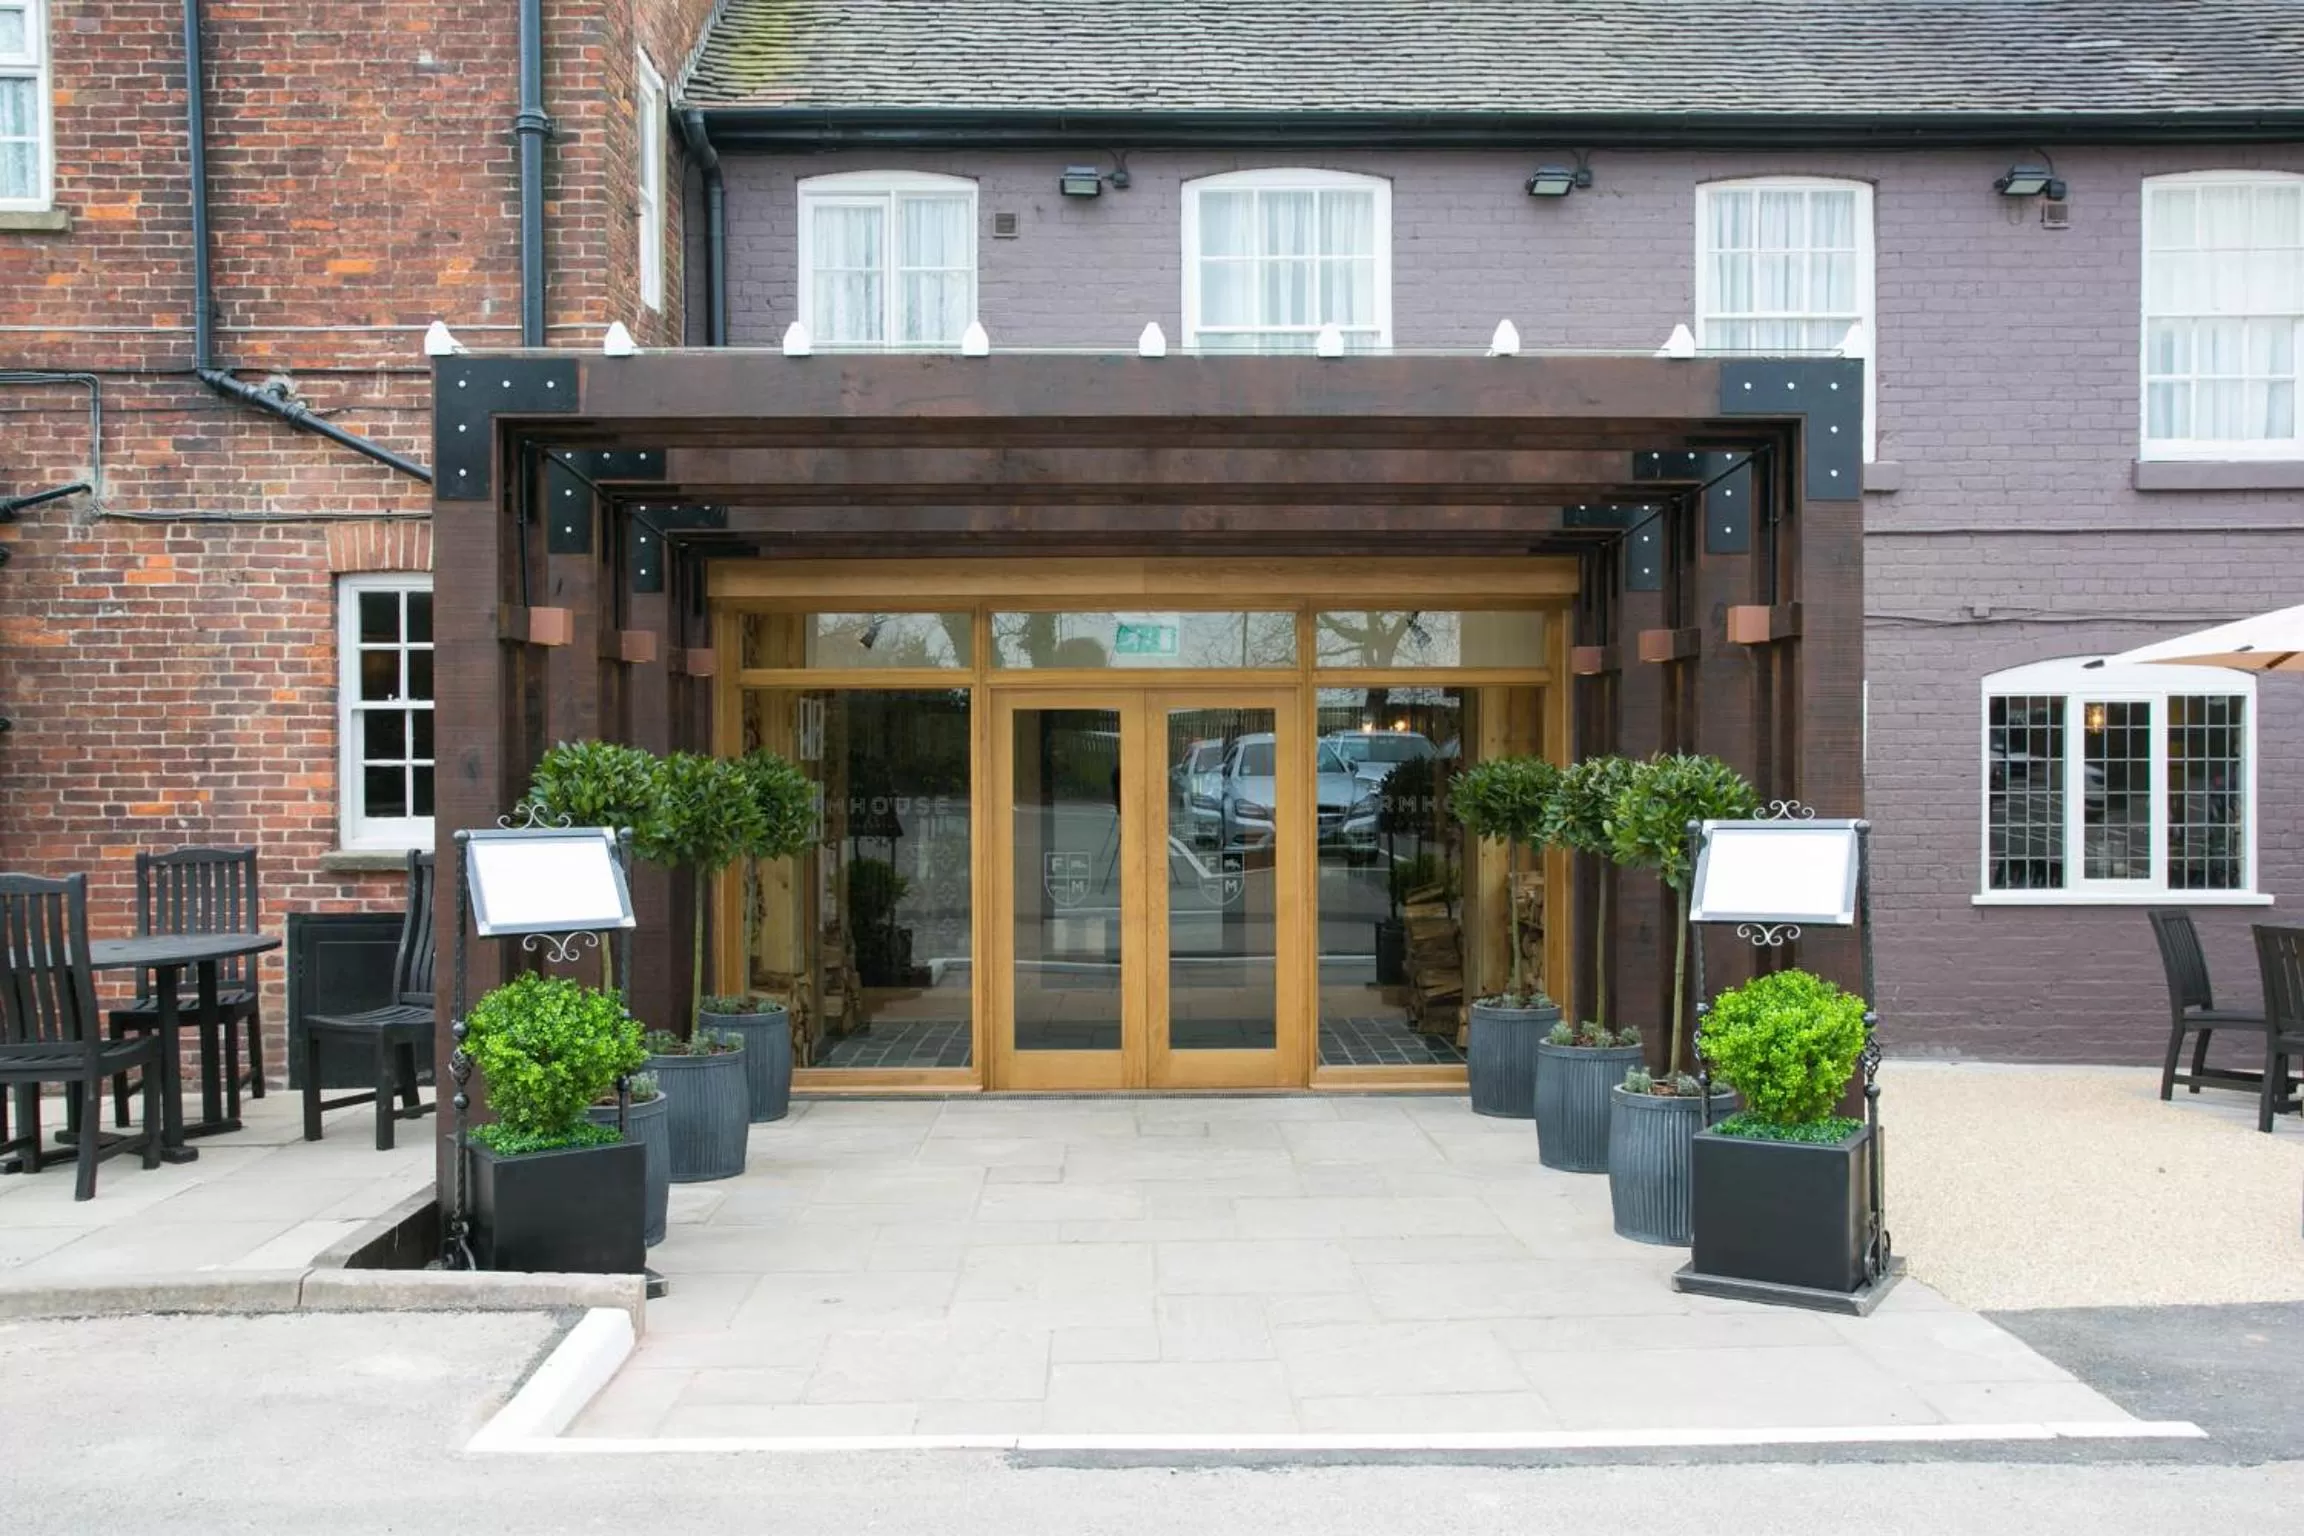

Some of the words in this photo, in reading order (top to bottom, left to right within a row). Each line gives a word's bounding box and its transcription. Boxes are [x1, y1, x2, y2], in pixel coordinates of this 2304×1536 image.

[825, 795, 950, 815] MHOUSE
[1052, 857, 1064, 871] F
[1071, 880, 1084, 893] M
[1225, 880, 1238, 893] M
